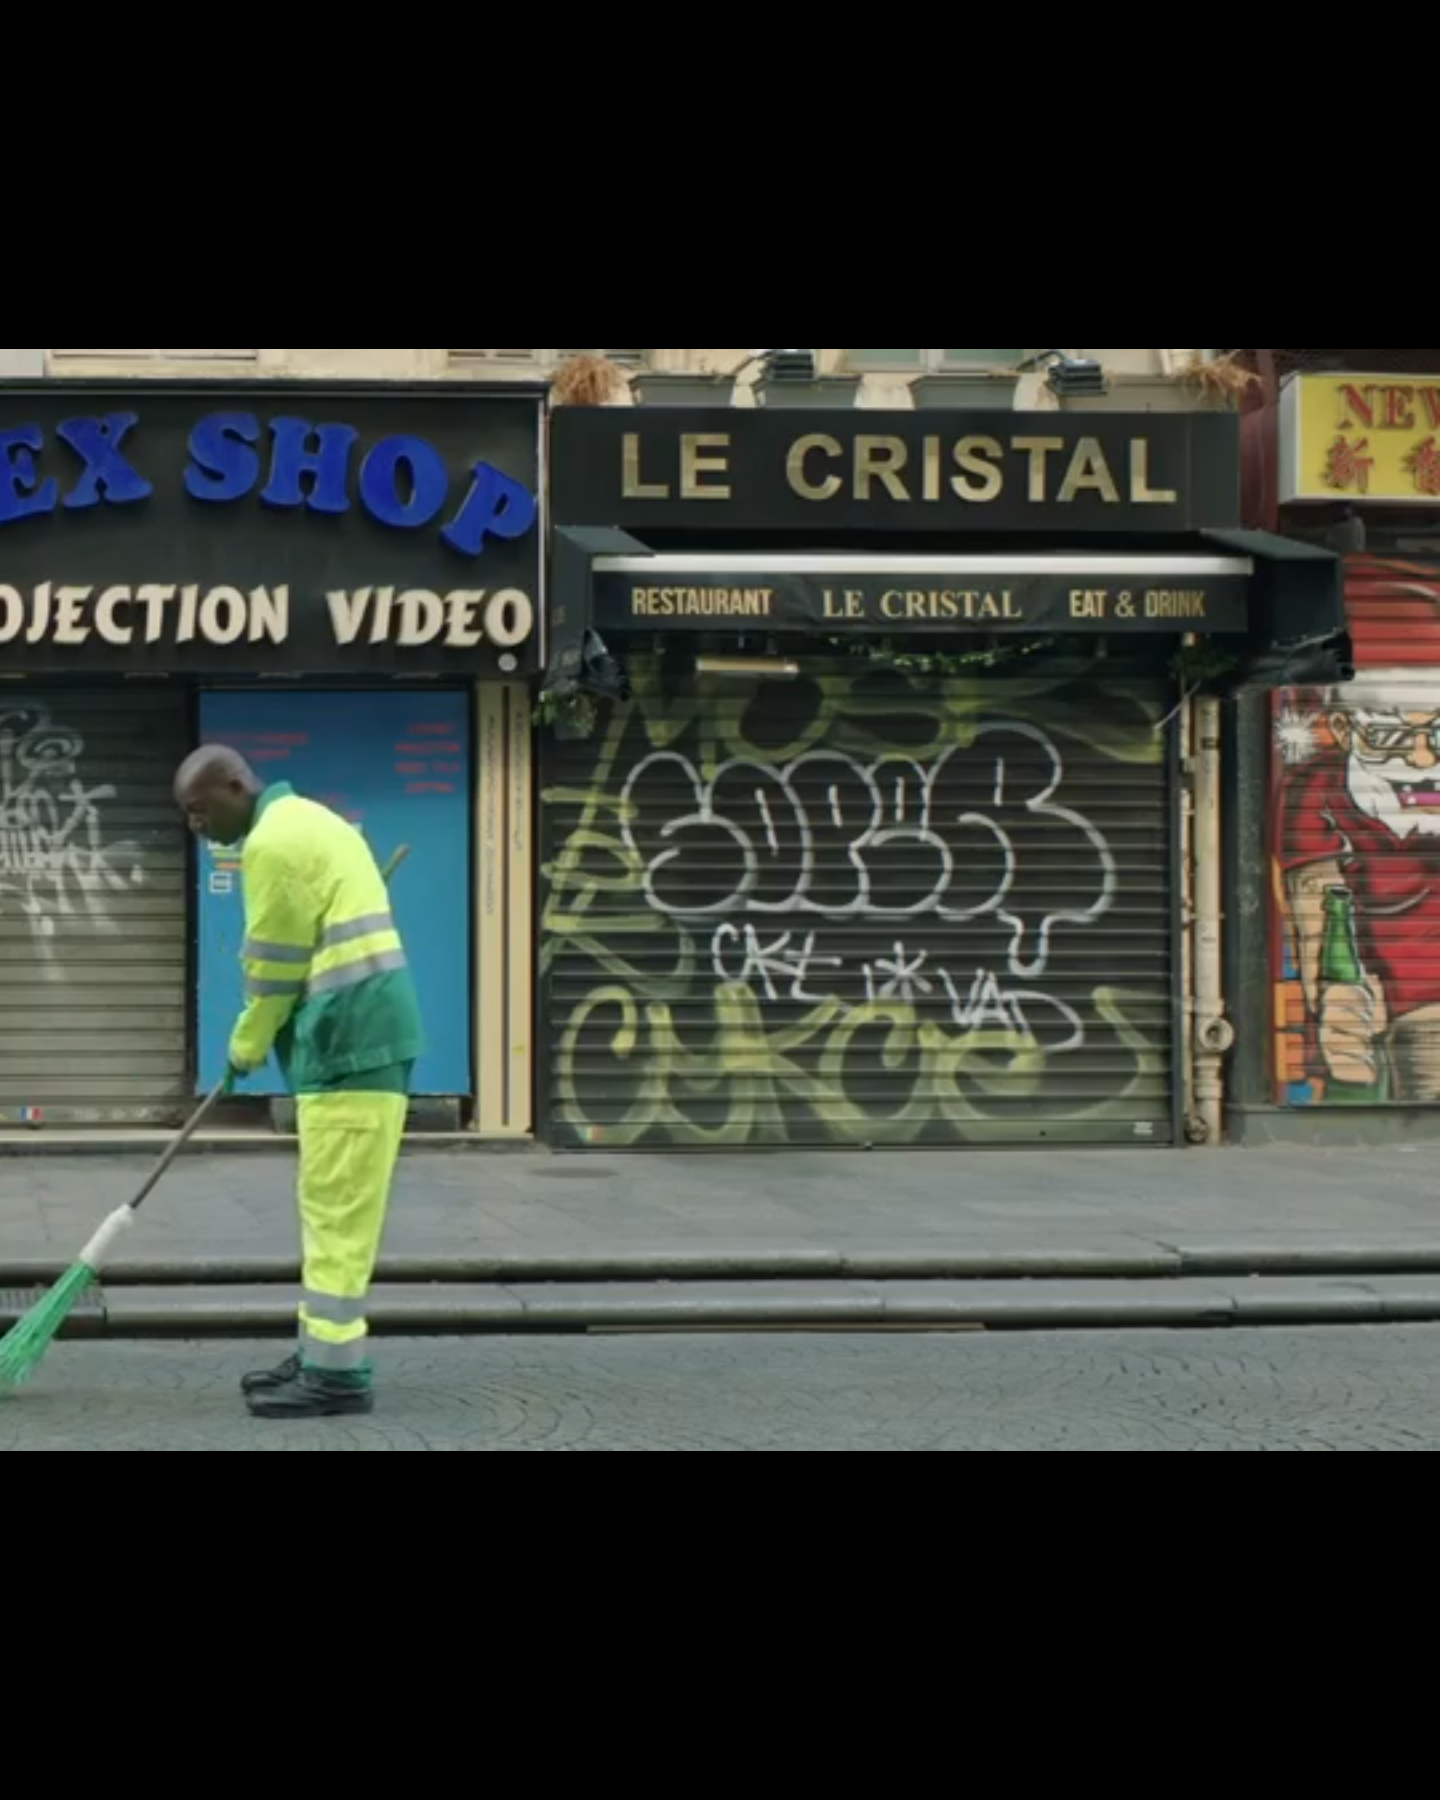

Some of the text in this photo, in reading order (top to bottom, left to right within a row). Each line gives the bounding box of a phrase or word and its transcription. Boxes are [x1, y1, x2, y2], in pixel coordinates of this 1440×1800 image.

[184, 412, 538, 555] SHOP
[621, 433, 1177, 503] LE CRISTAL
[326, 585, 534, 647] VIDEO
[631, 587, 772, 616] RESTAURANT
[822, 589, 1023, 619] LE CRISTAL
[1069, 589, 1206, 618] EAT & DRINK
